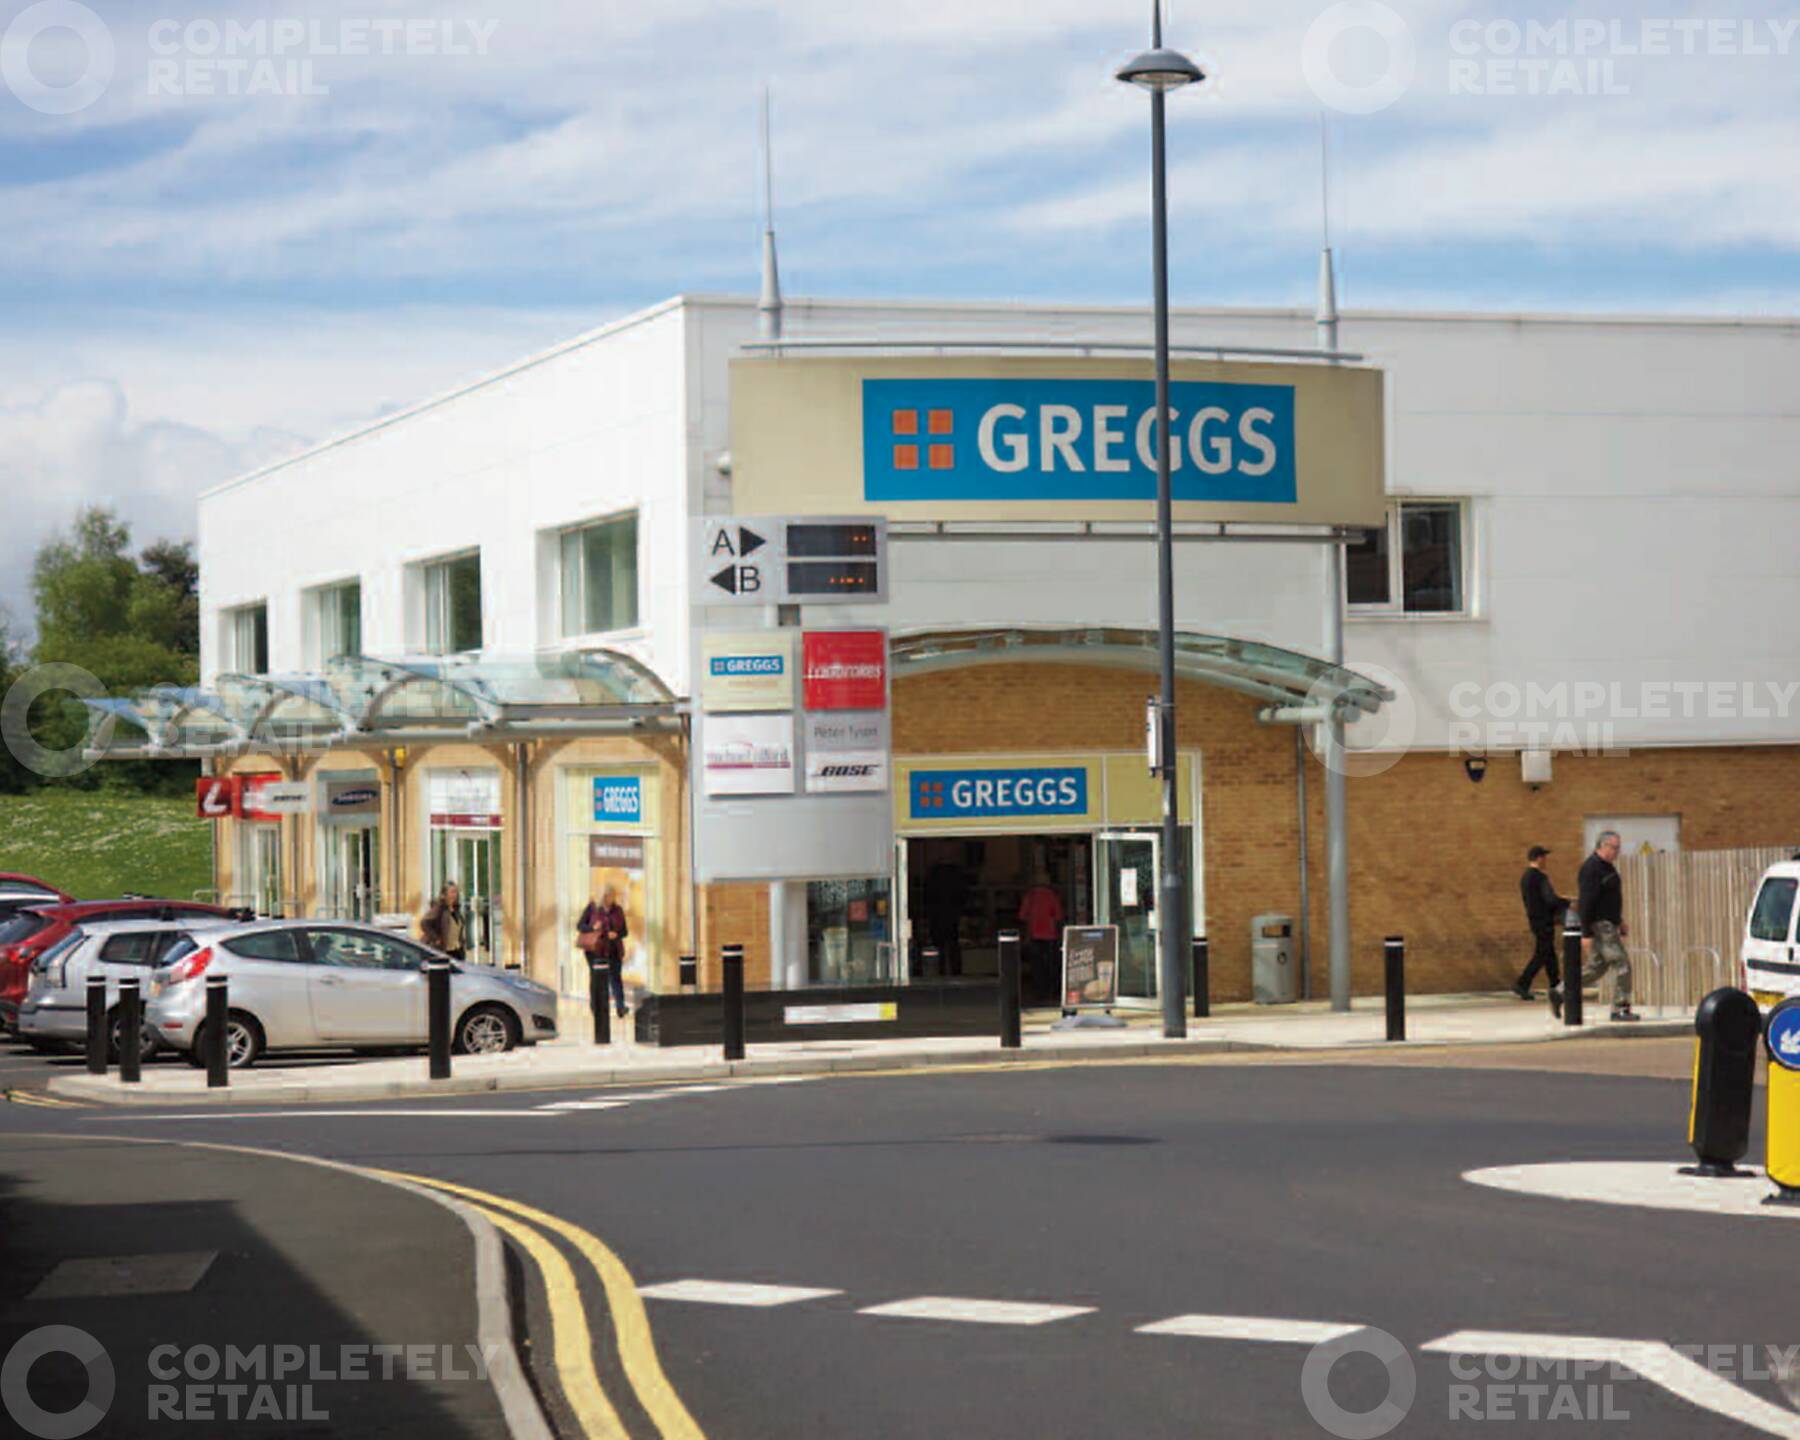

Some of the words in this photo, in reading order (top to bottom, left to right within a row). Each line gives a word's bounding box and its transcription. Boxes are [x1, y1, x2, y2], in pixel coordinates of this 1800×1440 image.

[977, 403, 1277, 475] GREGGS
[711, 528, 735, 556] A
[740, 566, 761, 592] B
[727, 659, 780, 672] GREGGS
[813, 764, 881, 777] BOSE
[604, 786, 638, 813] GREGGS
[952, 777, 1077, 808] GREGGS
